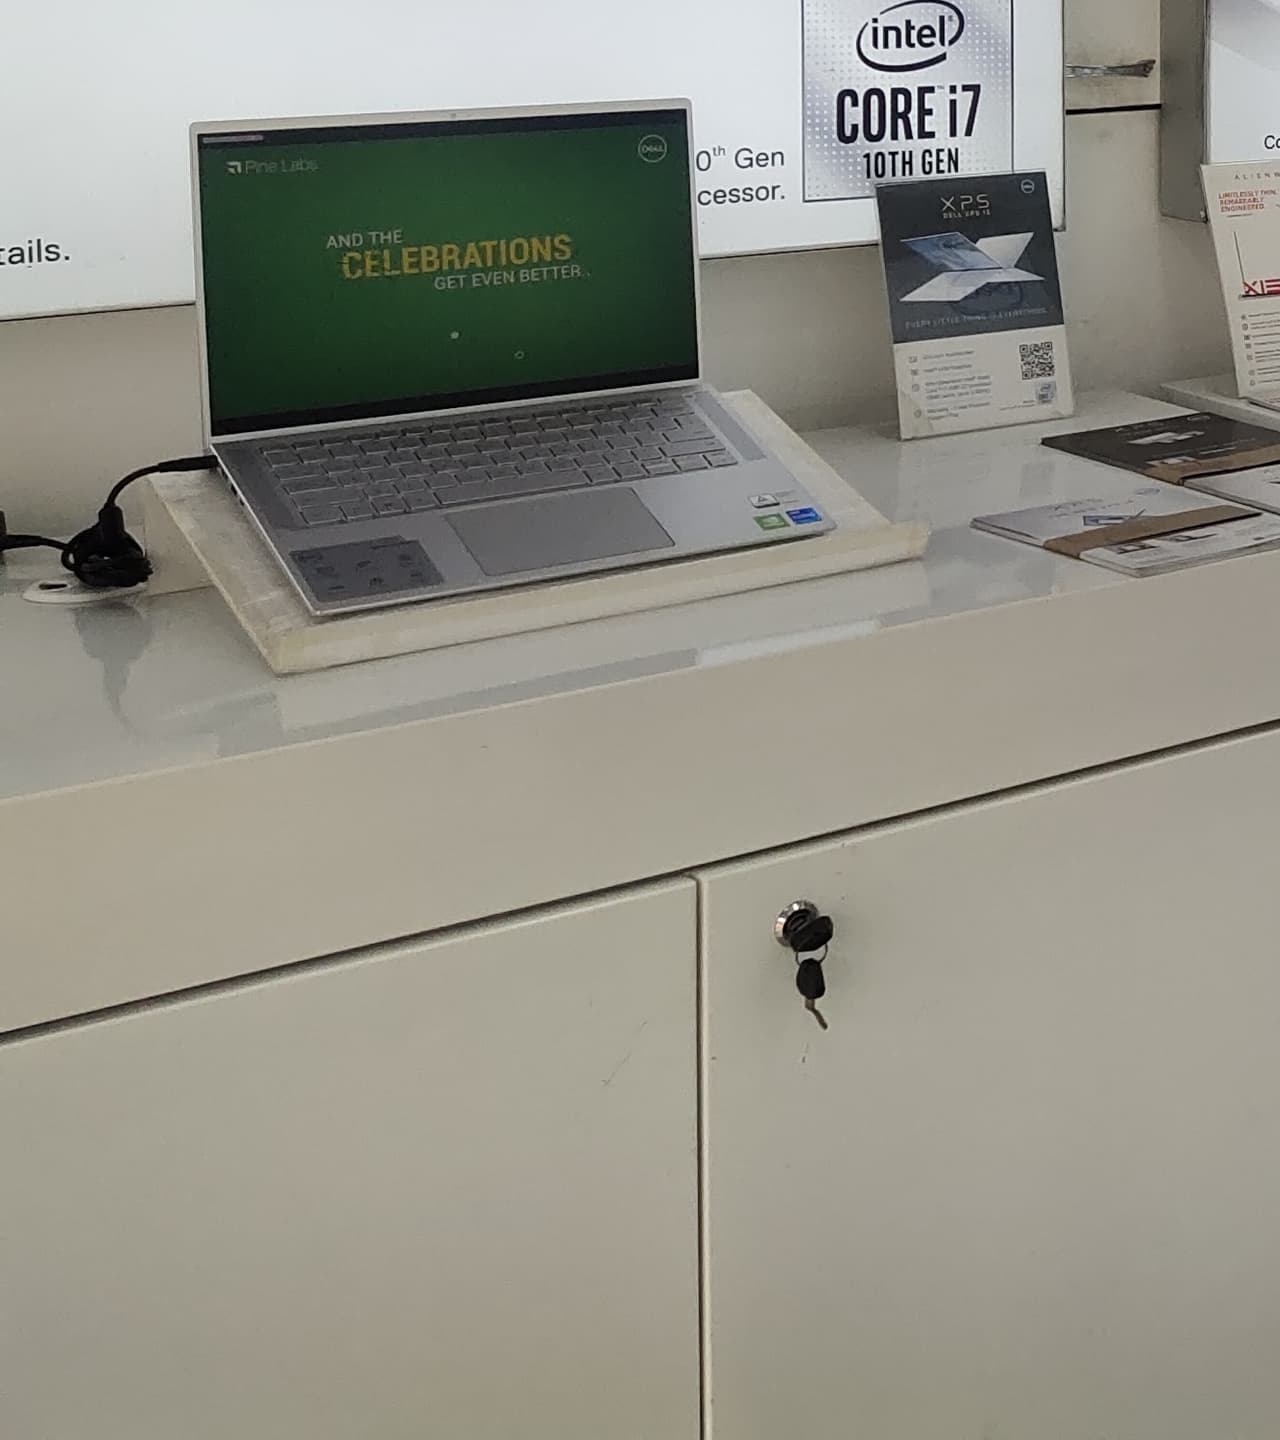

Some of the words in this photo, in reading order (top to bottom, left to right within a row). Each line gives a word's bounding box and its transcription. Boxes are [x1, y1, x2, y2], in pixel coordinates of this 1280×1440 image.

[872, 14, 950, 50] intel
[836, 86, 937, 144] CORE
[949, 84, 982, 138] i7
[696, 145, 726, 172] 0th
[735, 148, 785, 170] Gen
[863, 150, 913, 179] 10TH
[921, 148, 959, 174] GEN
[697, 185, 786, 206] cessor.
[940, 193, 990, 211] XPS
[326, 233, 364, 249] AND
[367, 229, 403, 246] THE
[342, 234, 571, 279] CELEBRATIONS
[434, 274, 466, 290] GET
[472, 270, 514, 287] EVEN
